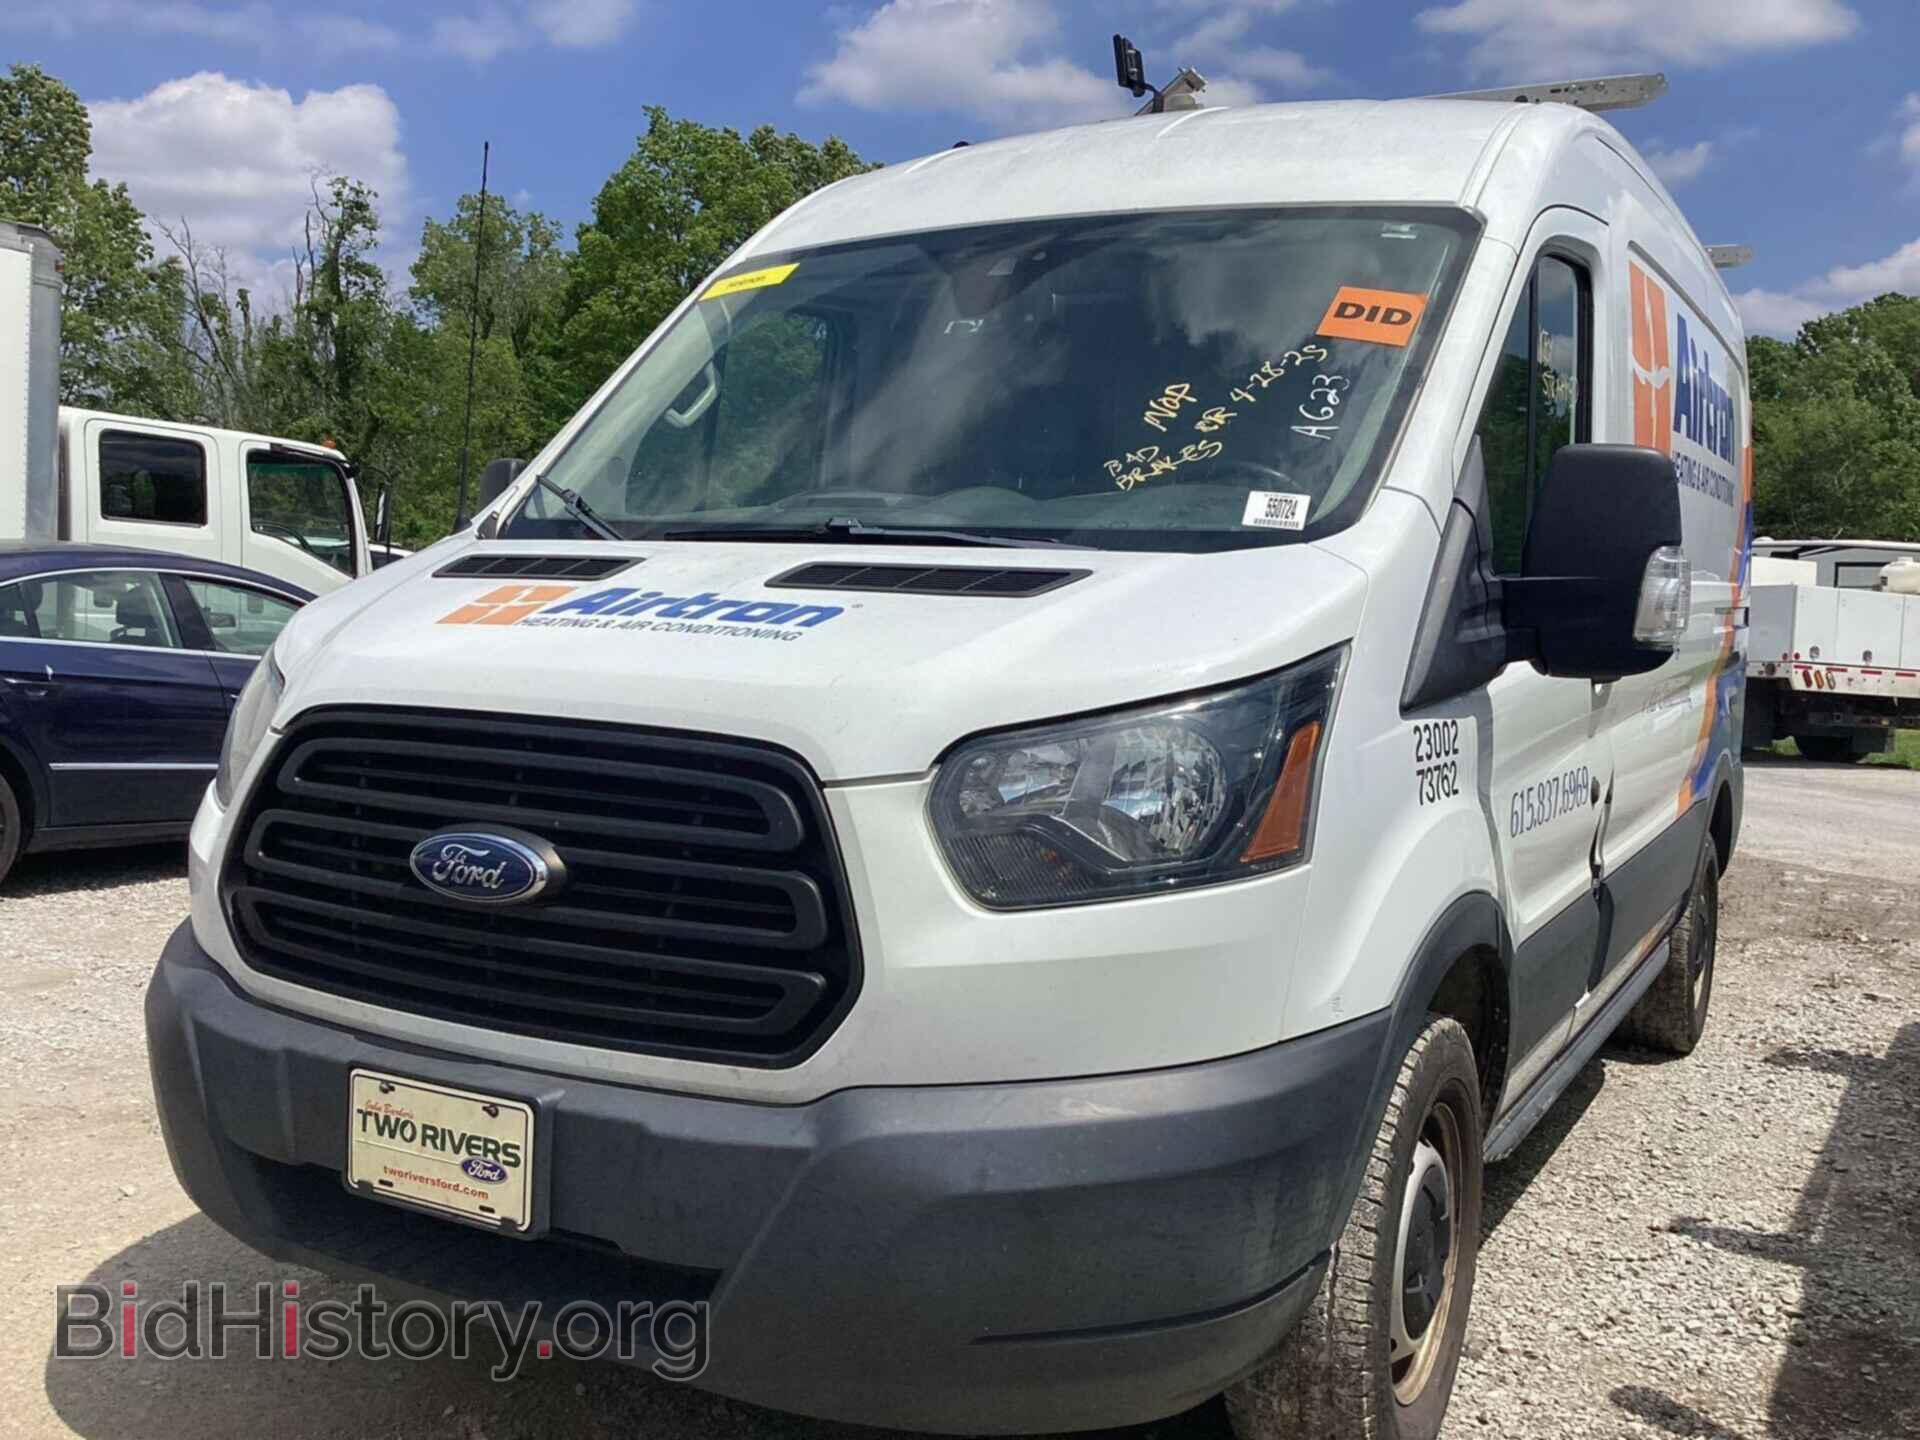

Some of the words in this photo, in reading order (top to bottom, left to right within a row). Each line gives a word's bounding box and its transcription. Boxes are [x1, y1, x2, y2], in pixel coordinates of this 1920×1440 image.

[1333, 301, 1413, 327] DID
[1673, 311, 1735, 466] Airtron
[1103, 445, 1159, 477] BAD
[1115, 439, 1223, 491] BRAKES
[538, 587, 845, 628] Airtron
[519, 617, 595, 628] HEATING
[595, 619, 614, 630] &
[616, 620, 651, 632] AIR
[651, 621, 803, 642] CONDITIONING
[1412, 719, 1460, 762] 23002
[1415, 760, 1460, 805] 73762
[1510, 765, 1590, 838] 615.837.6969
[431, 843, 510, 889] Ford
[356, 1108, 417, 1144] TWO
[421, 1123, 522, 1169] RIVERS
[383, 1165, 490, 1201] tworiversford.com
[467, 1158, 502, 1181] Ford
